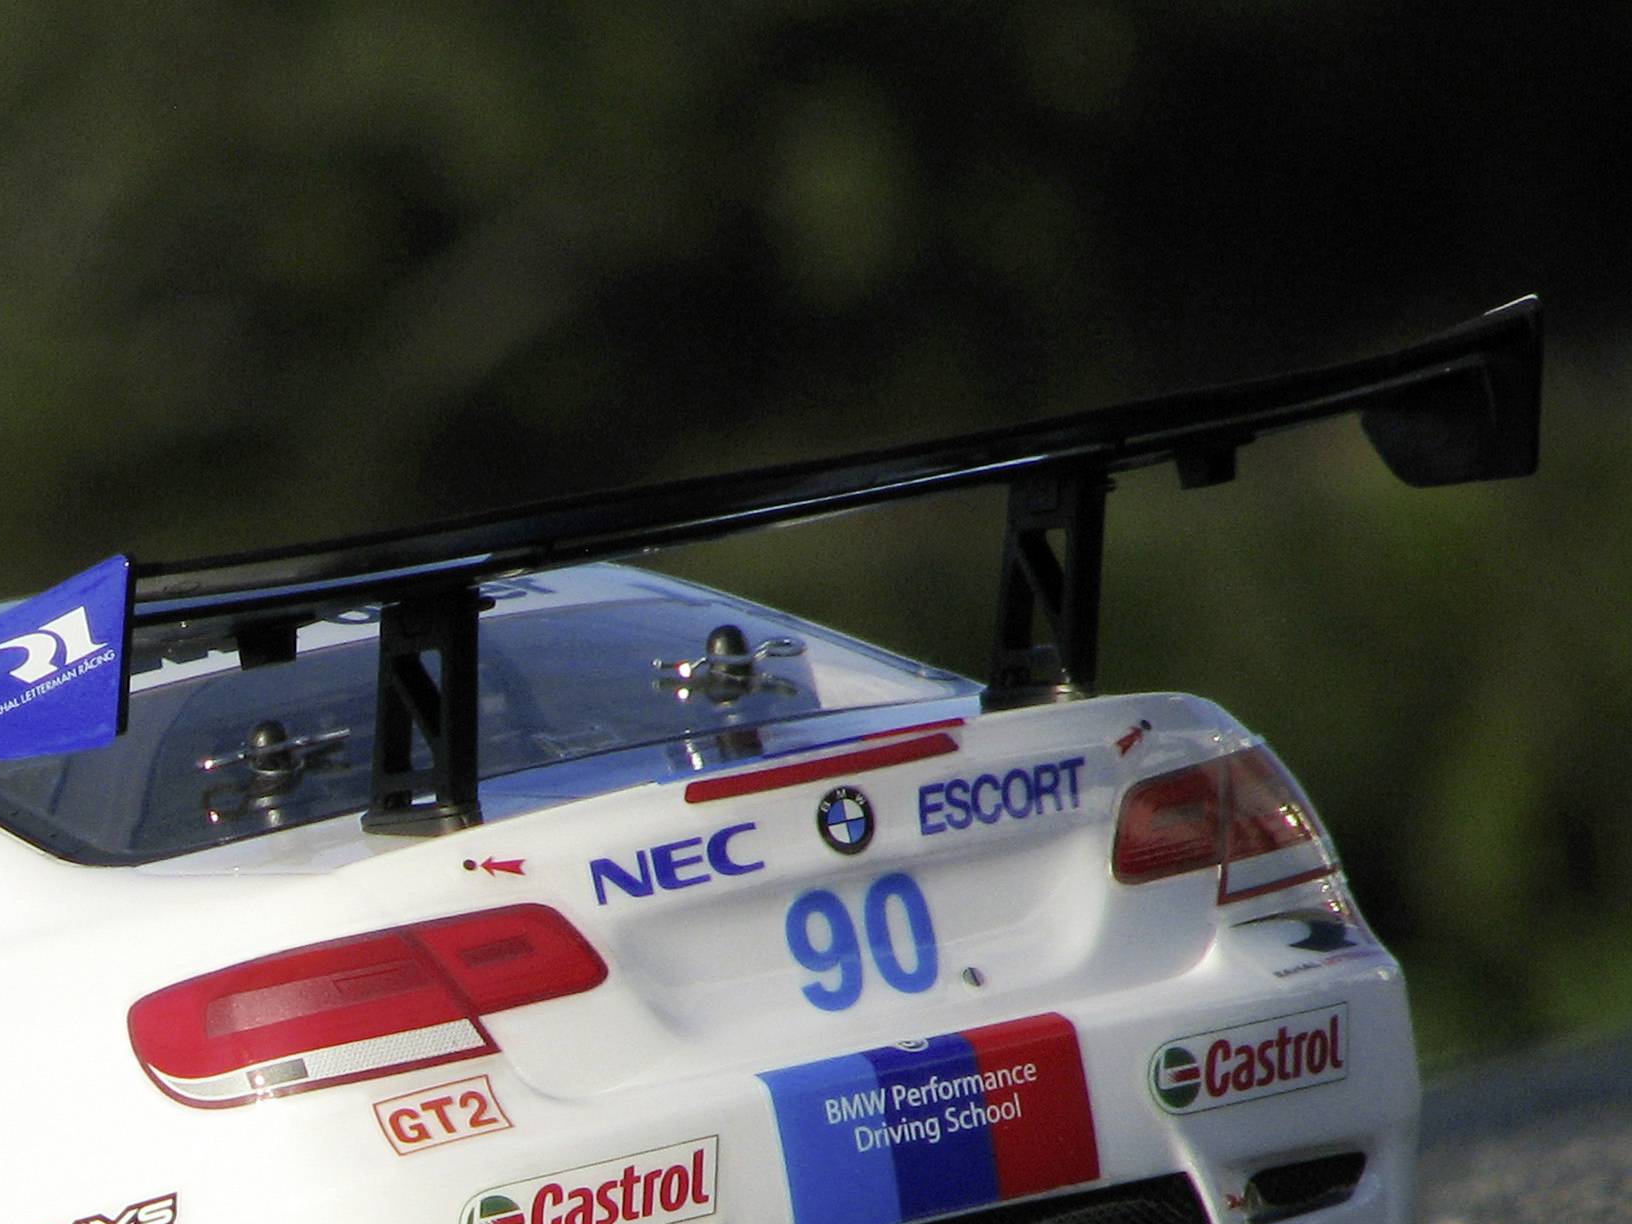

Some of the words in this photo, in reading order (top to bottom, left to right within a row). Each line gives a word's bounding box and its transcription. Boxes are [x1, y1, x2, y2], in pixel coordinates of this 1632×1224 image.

[20, 668, 77, 704] LETTERMAN
[78, 649, 116, 675] RACING
[918, 757, 1085, 836] ESCORT
[589, 821, 765, 905] NEC
[785, 872, 939, 1011] 90
[1205, 1014, 1344, 1098] Castrol
[388, 1090, 498, 1143] GT2
[825, 1088, 886, 1124] BMW
[892, 1062, 1038, 1110] Performance
[854, 1117, 941, 1152] Driving
[945, 1093, 1022, 1134] School
